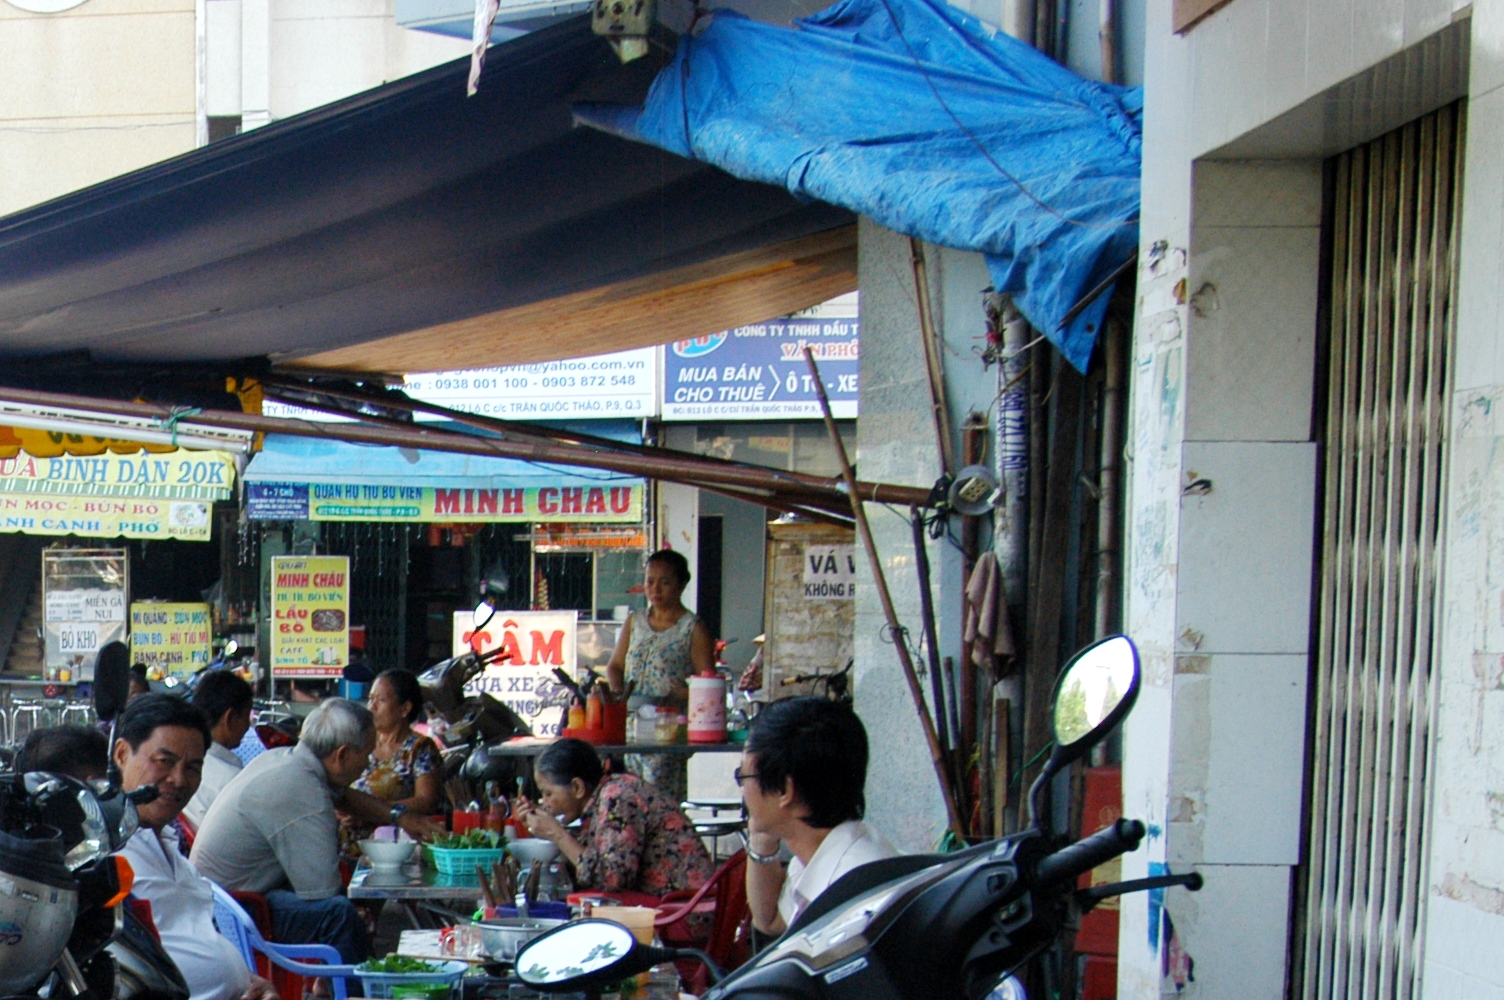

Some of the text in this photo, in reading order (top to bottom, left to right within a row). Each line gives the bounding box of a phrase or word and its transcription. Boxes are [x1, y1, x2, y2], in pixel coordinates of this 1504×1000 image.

[769, 324, 785, 337] TY
[787, 323, 821, 337] TNHH
[435, 378, 469, 390] 0938
[473, 377, 497, 390] 001
[504, 377, 528, 389] 100
[542, 376, 576, 388] 0903
[580, 375, 606, 387] 872
[610, 374, 636, 387] 548
[678, 363, 762, 383] MUA BÁN
[837, 374, 858, 392] XE
[674, 383, 766, 402] CHO THUÊ
[483, 402, 491, 412] C
[177, 461, 227, 485] 20K
[24, 499, 68, 513] MỌC
[84, 500, 127, 514] BÚN
[132, 500, 160, 515] BÒ
[433, 487, 526, 515] MINH
[41, 518, 101, 532] CANH
[809, 549, 839, 574] VÁ
[277, 572, 310, 588] MINH
[804, 579, 845, 597] KHÔNG
[77, 630, 97, 649] KHO
[462, 619, 565, 666] TÂM
[507, 677, 534, 692] XE
